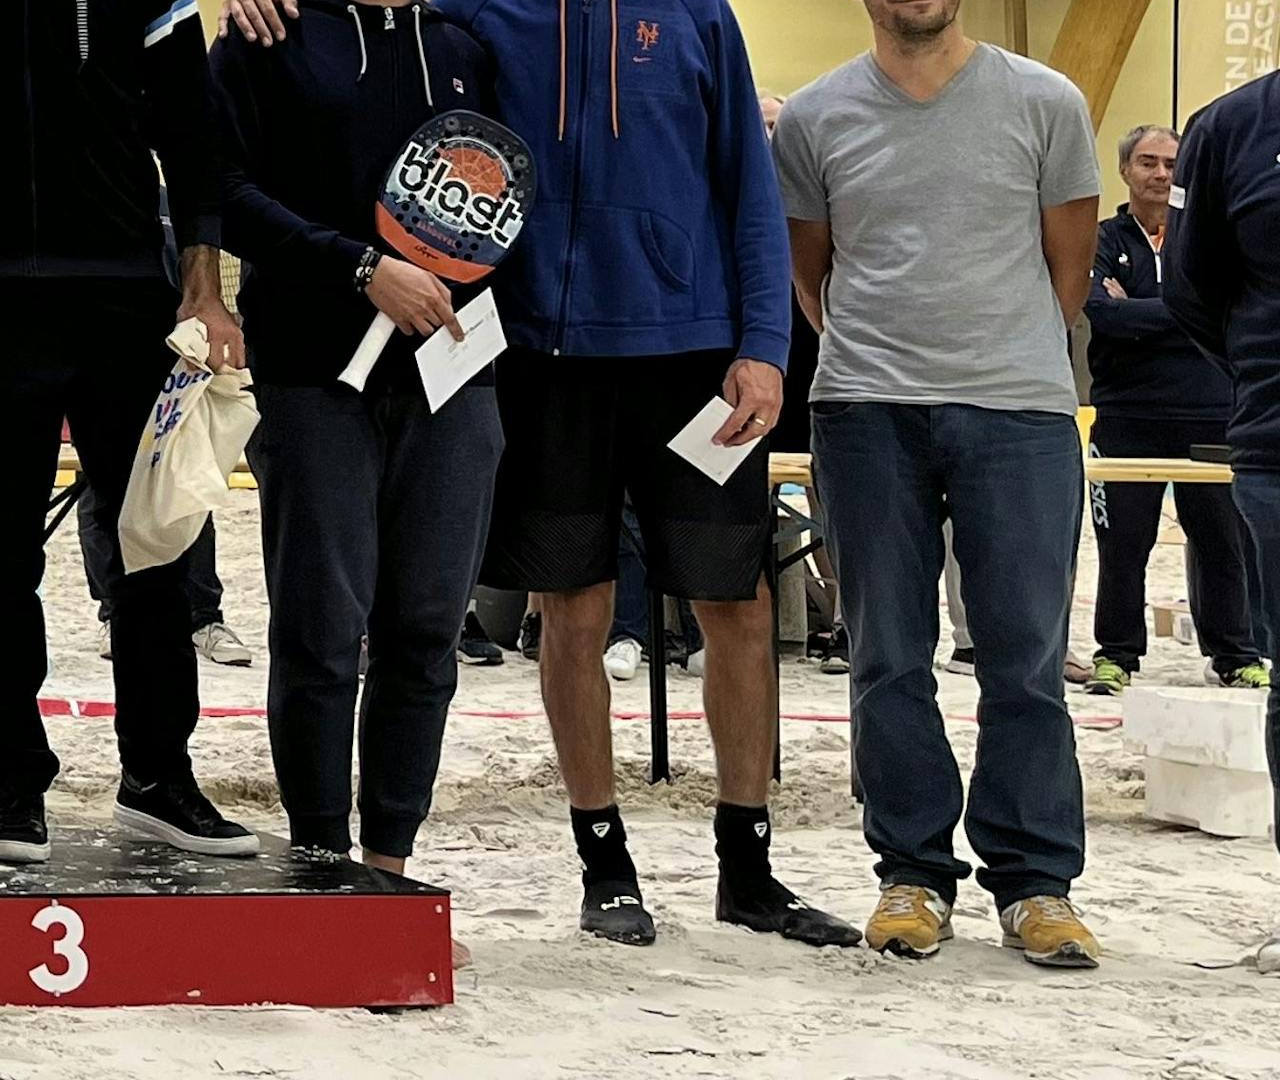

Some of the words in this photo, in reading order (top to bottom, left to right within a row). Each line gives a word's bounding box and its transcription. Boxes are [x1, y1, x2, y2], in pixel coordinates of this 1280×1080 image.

[1225, 1, 1252, 46] DE
[397, 142, 525, 248] blast
[28, 906, 89, 995] 3
